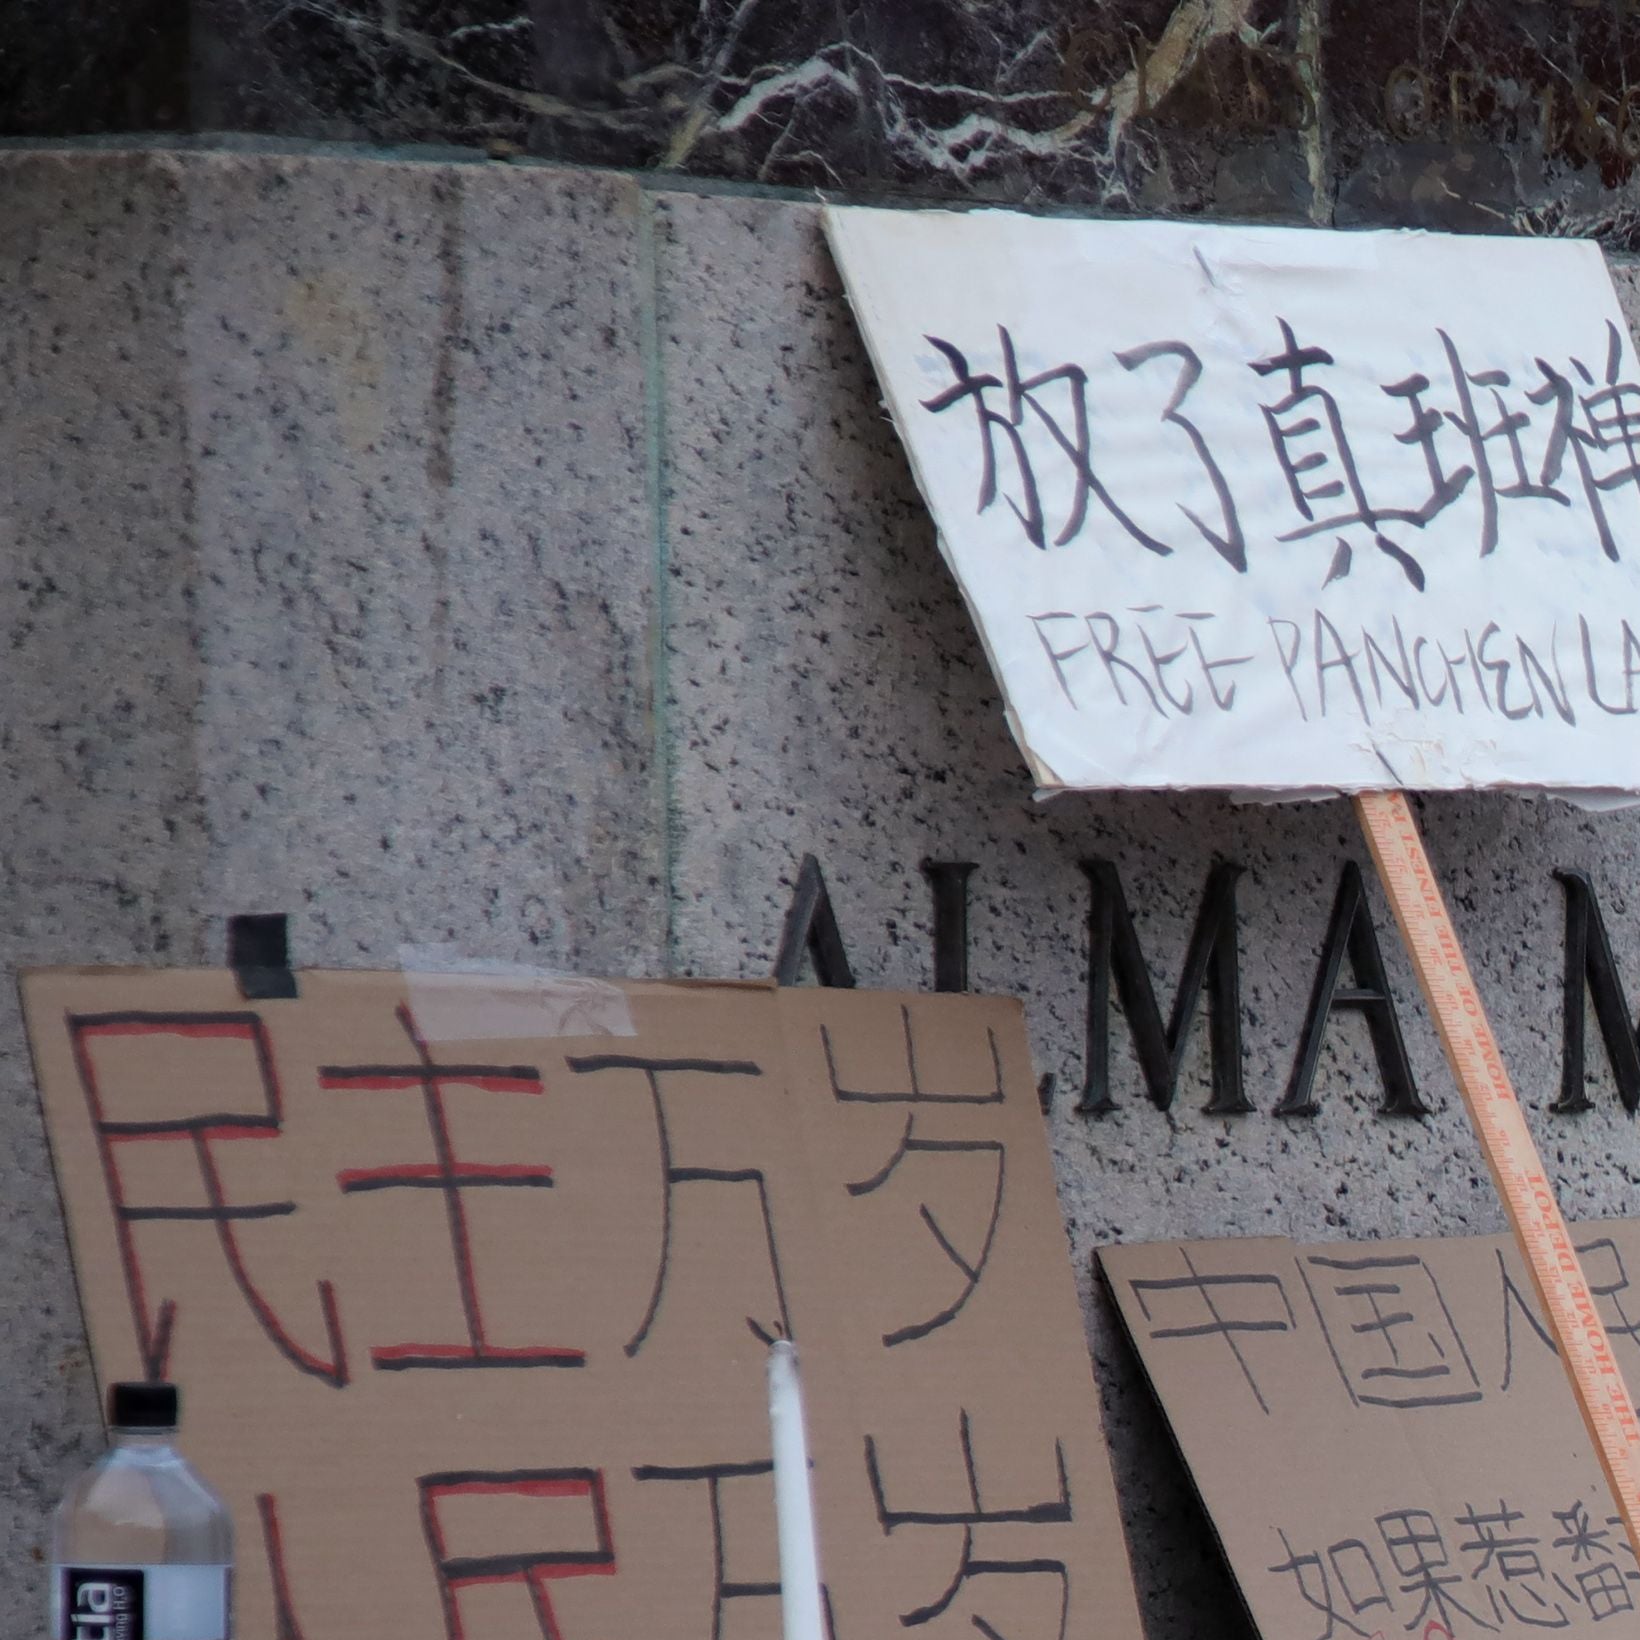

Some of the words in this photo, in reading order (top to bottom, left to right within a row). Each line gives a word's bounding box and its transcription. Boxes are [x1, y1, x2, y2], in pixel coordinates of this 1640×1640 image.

[1026, 604, 1254, 718] FREE
[1267, 608, 1576, 727] PANCHEN
[1436, 925, 1464, 975] THE
[1457, 982, 1479, 1018] OF
[1472, 1023, 1511, 1100] HOME
[65, 1003, 1005, 1390] 民主万岁
[1525, 1168, 1577, 1274] DEPOT
[1570, 1287, 1617, 1376] HOME
